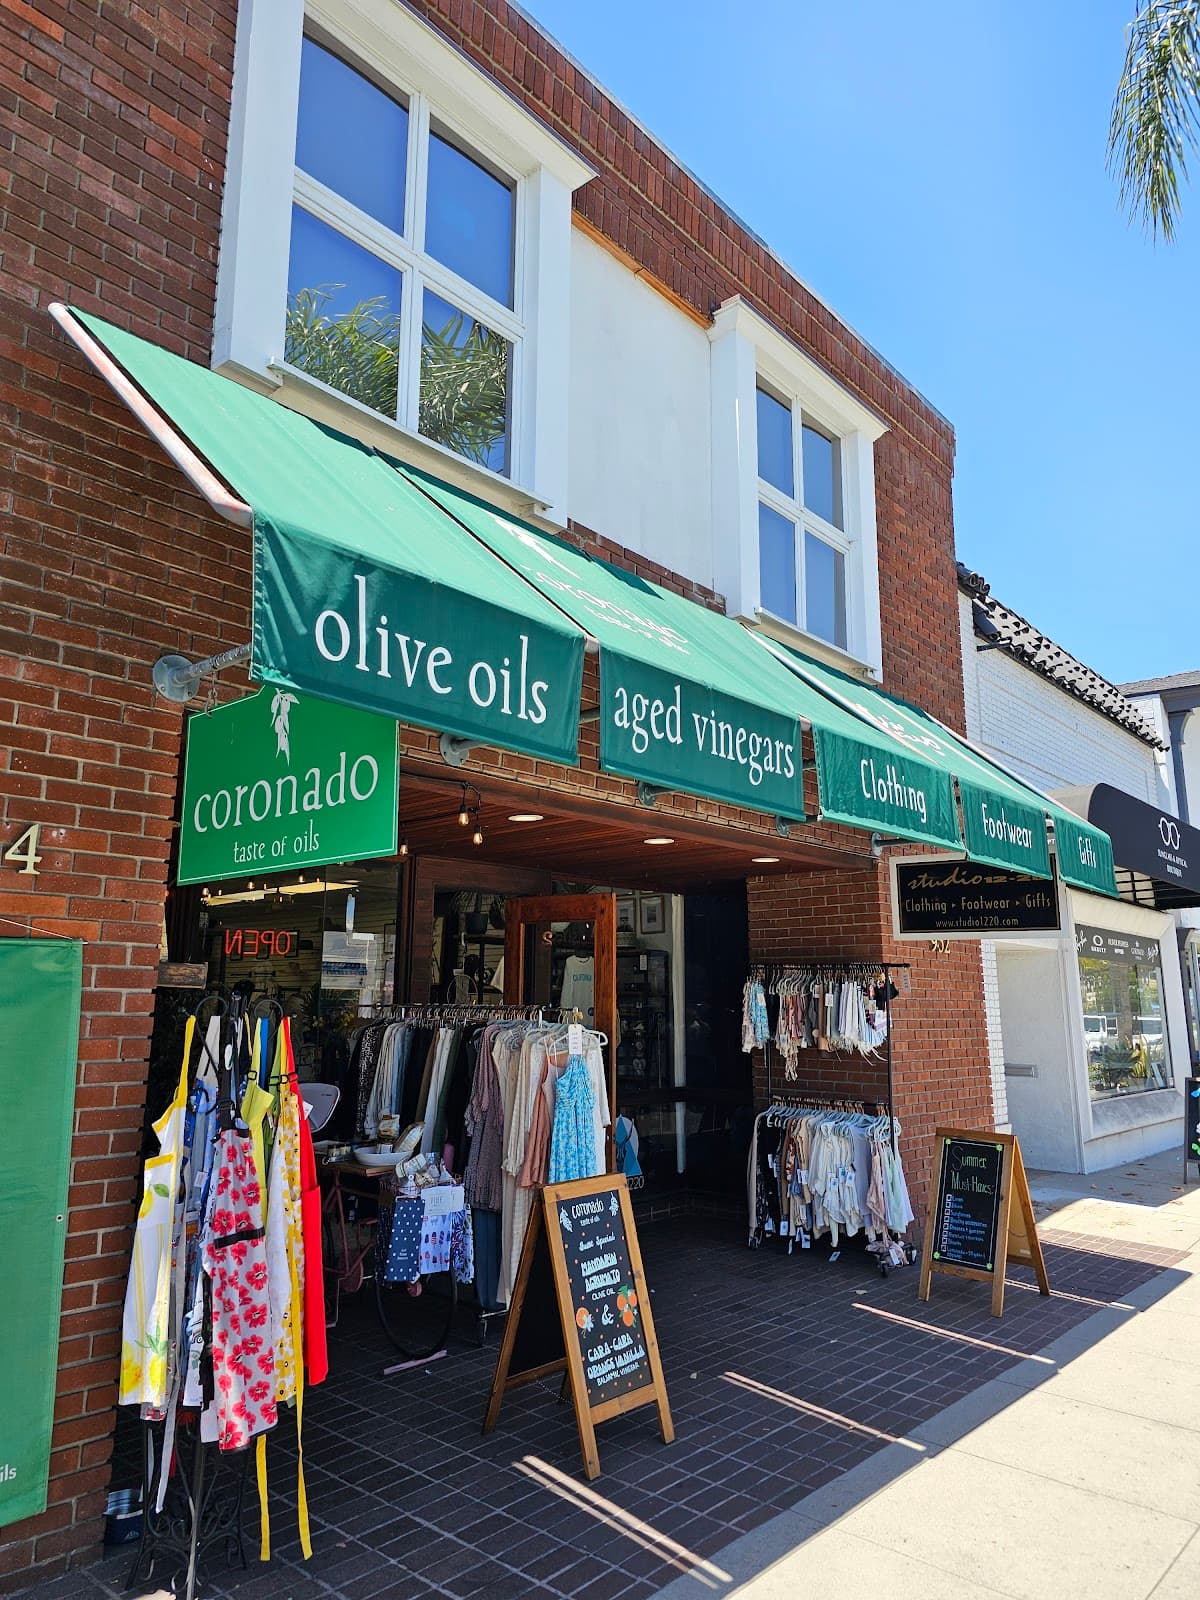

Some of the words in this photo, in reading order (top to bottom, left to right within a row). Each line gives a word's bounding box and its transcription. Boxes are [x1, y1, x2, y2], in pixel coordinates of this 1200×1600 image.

[315, 574, 453, 694] olive
[469, 635, 549, 724] oils
[614, 684, 683, 754] aged
[692, 710, 795, 786] vinegars
[194, 752, 379, 832] coronado
[860, 759, 927, 824] Clothing
[233, 840, 265, 864] taste
[271, 836, 287, 856] of
[294, 820, 319, 853] oils
[982, 803, 1033, 849] Footwear
[4, 824, 42, 875] 4
[1078, 836, 1097, 869] Gifts
[905, 897, 947, 914] Clothing
[961, 895, 1010, 910] Footwear
[1025, 892, 1051, 908] Gifts
[935, 916, 1019, 928] www.studio1220.com
[601, 1304, 614, 1325] &
